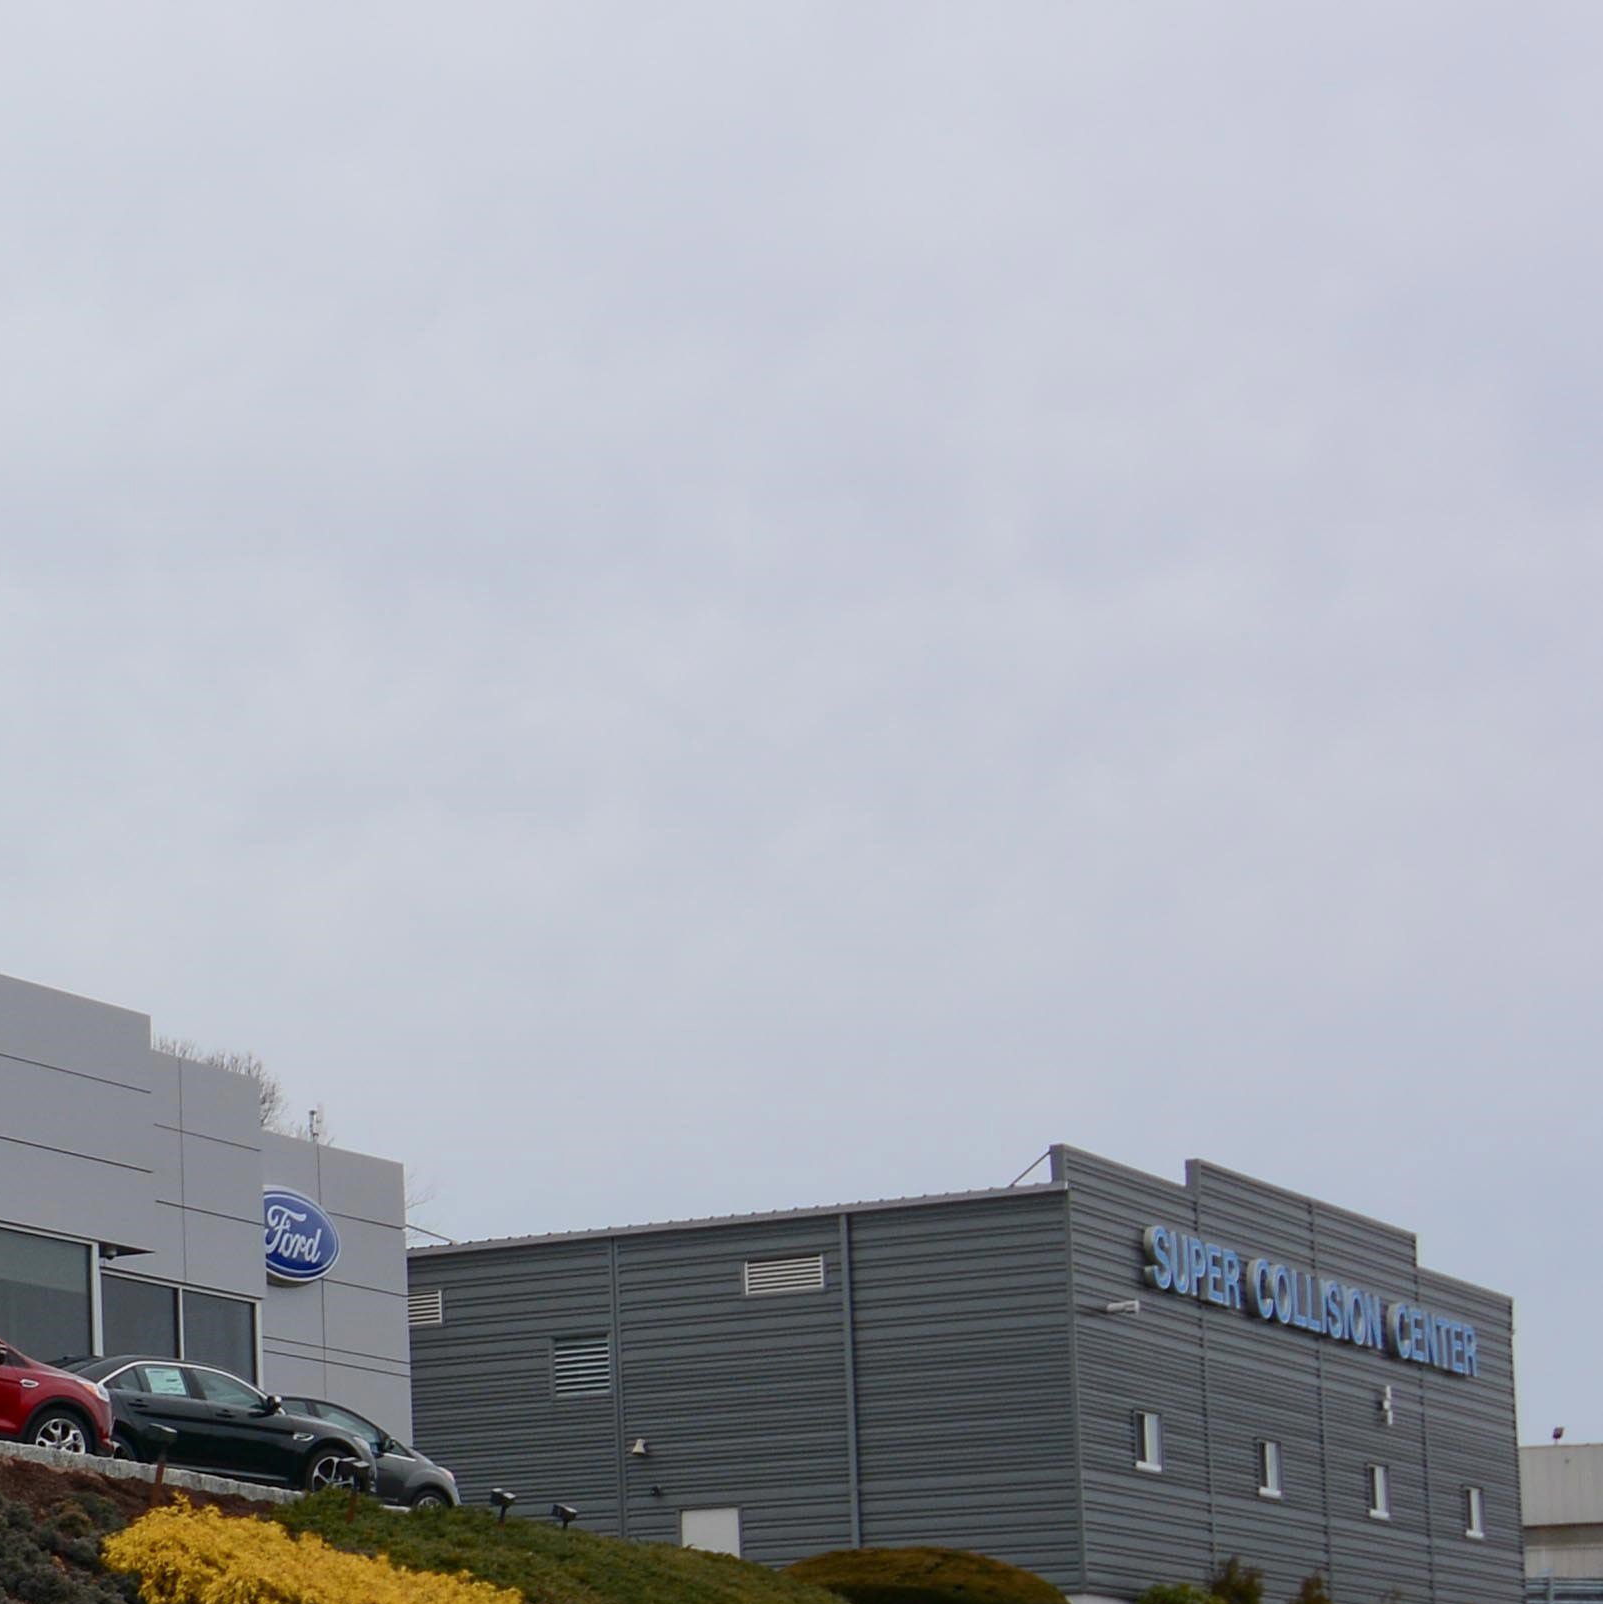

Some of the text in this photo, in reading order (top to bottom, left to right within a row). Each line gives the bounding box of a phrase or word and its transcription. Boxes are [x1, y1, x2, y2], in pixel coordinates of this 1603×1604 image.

[265, 1204, 322, 1263] Ford
[1144, 1225, 1479, 1377] SUPER COLLISION CENTER
